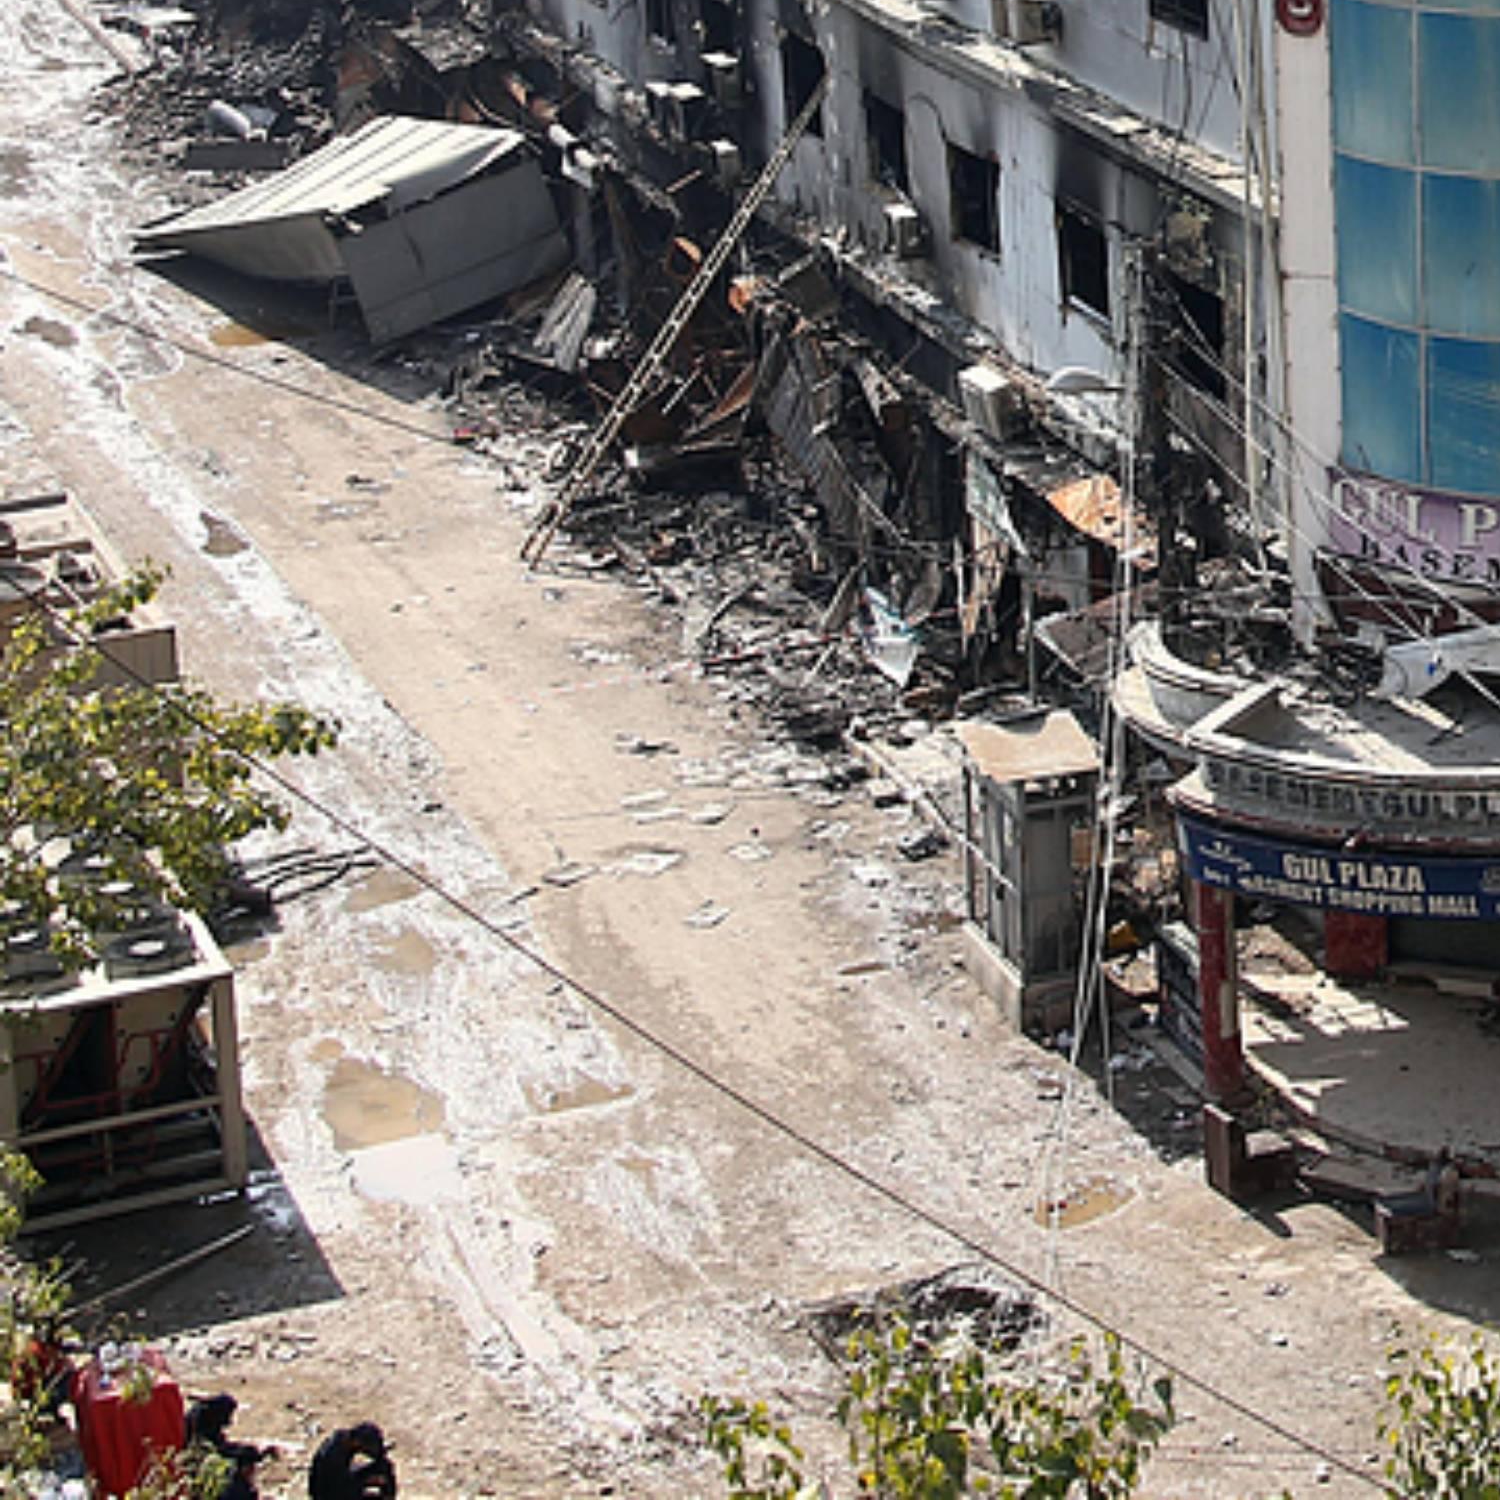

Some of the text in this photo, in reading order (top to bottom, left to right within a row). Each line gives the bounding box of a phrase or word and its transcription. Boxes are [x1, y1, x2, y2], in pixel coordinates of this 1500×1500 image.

[1331, 476, 1437, 546] GUL
[1282, 854, 1334, 883] GUL
[1338, 860, 1426, 893] PLAZA
